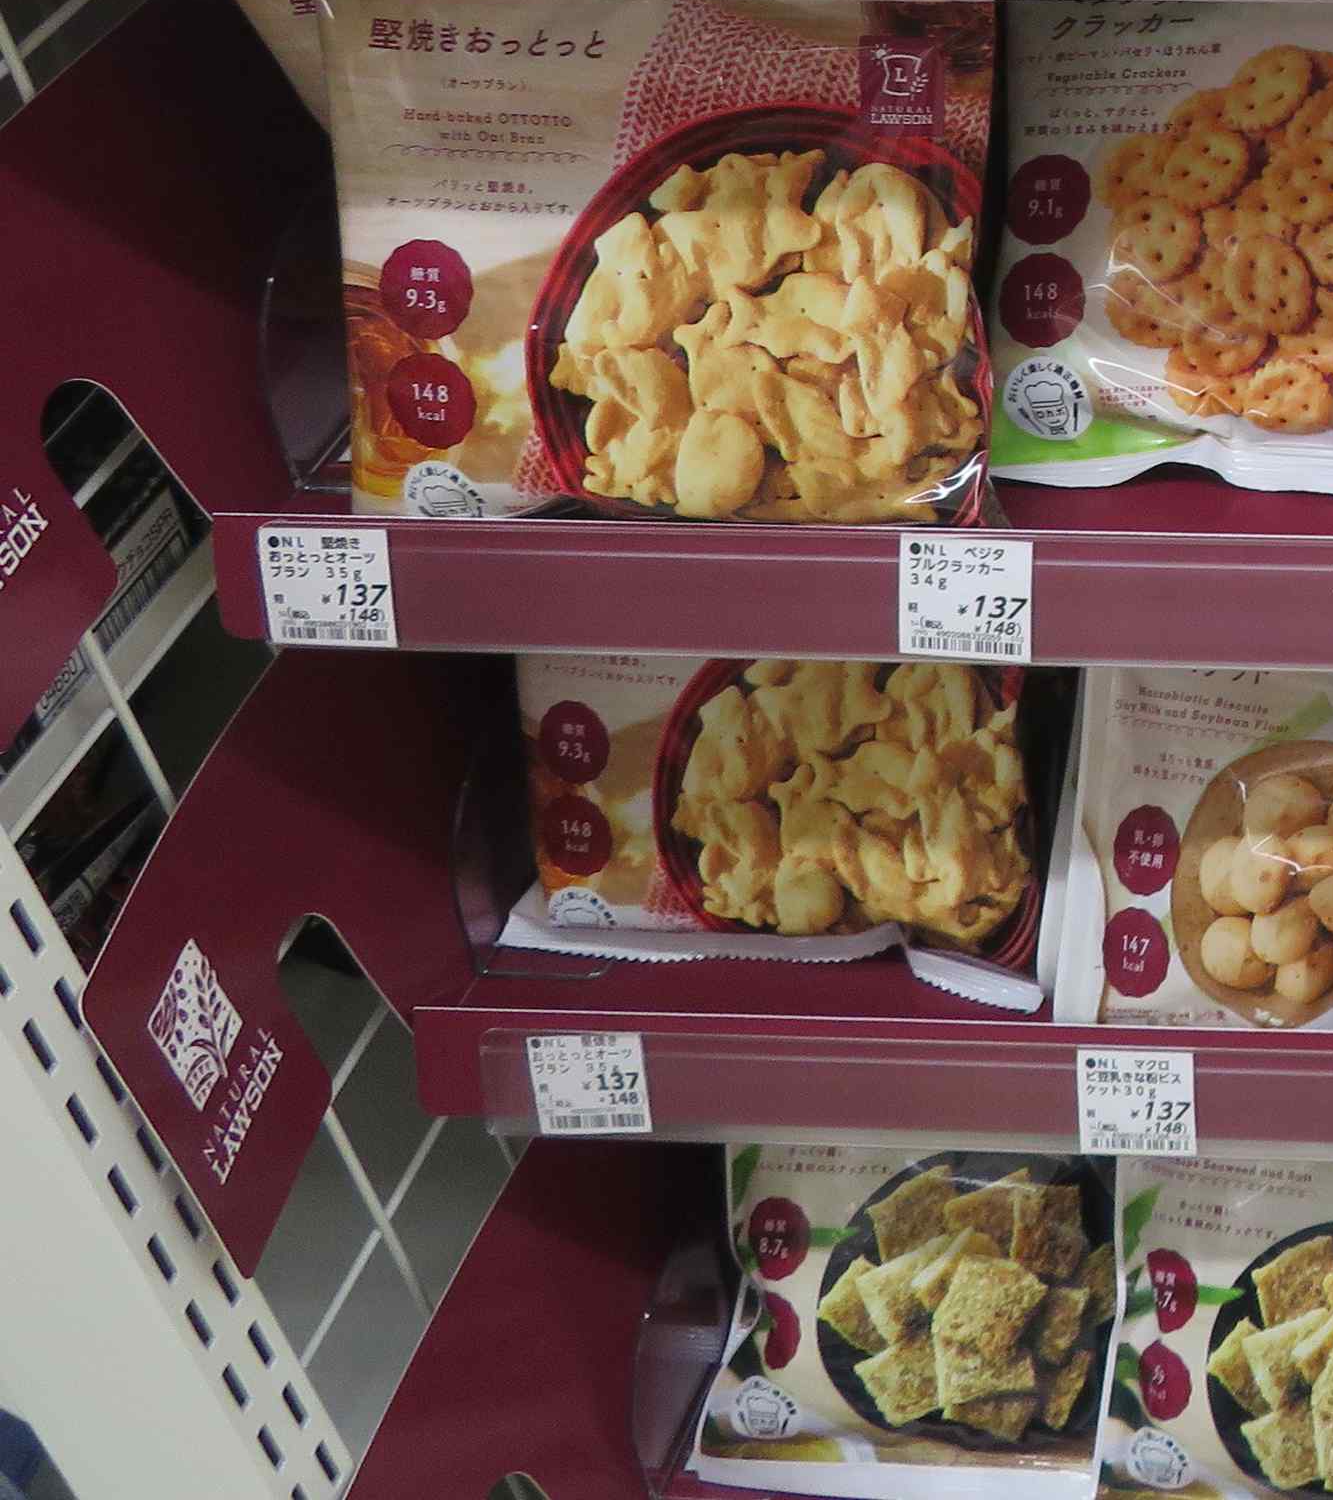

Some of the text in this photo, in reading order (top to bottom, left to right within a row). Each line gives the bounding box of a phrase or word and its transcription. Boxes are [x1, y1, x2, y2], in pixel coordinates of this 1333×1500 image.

[1052, 13, 1195, 40] クラッカー
[368, 18, 606, 59] 堅焼きおっとっと
[1122, 68, 1186, 79] Crackers
[498, 113, 572, 127] OTTOTTO
[869, 114, 935, 126] LAWSON
[1028, 198, 1064, 219] 9.1g
[405, 288, 447, 313] 9.3g
[1023, 284, 1058, 301] 148
[410, 382, 450, 404] 148
[416, 407, 446, 423] kcal
[321, 536, 361, 549] 堅焼き
[269, 552, 375, 564] おっとっとオーツ
[964, 547, 1005, 561] ベジタ
[270, 567, 362, 582] ブラン 35g
[910, 558, 1005, 575] ブルクラッカー
[910, 573, 948, 590] 34g
[560, 818, 593, 839] 148
[1127, 851, 1163, 869] 不使用
[1121, 933, 1149, 956] 147
[1122, 958, 1145, 973] kcal
[212, 1038, 283, 1185] LAWSON
